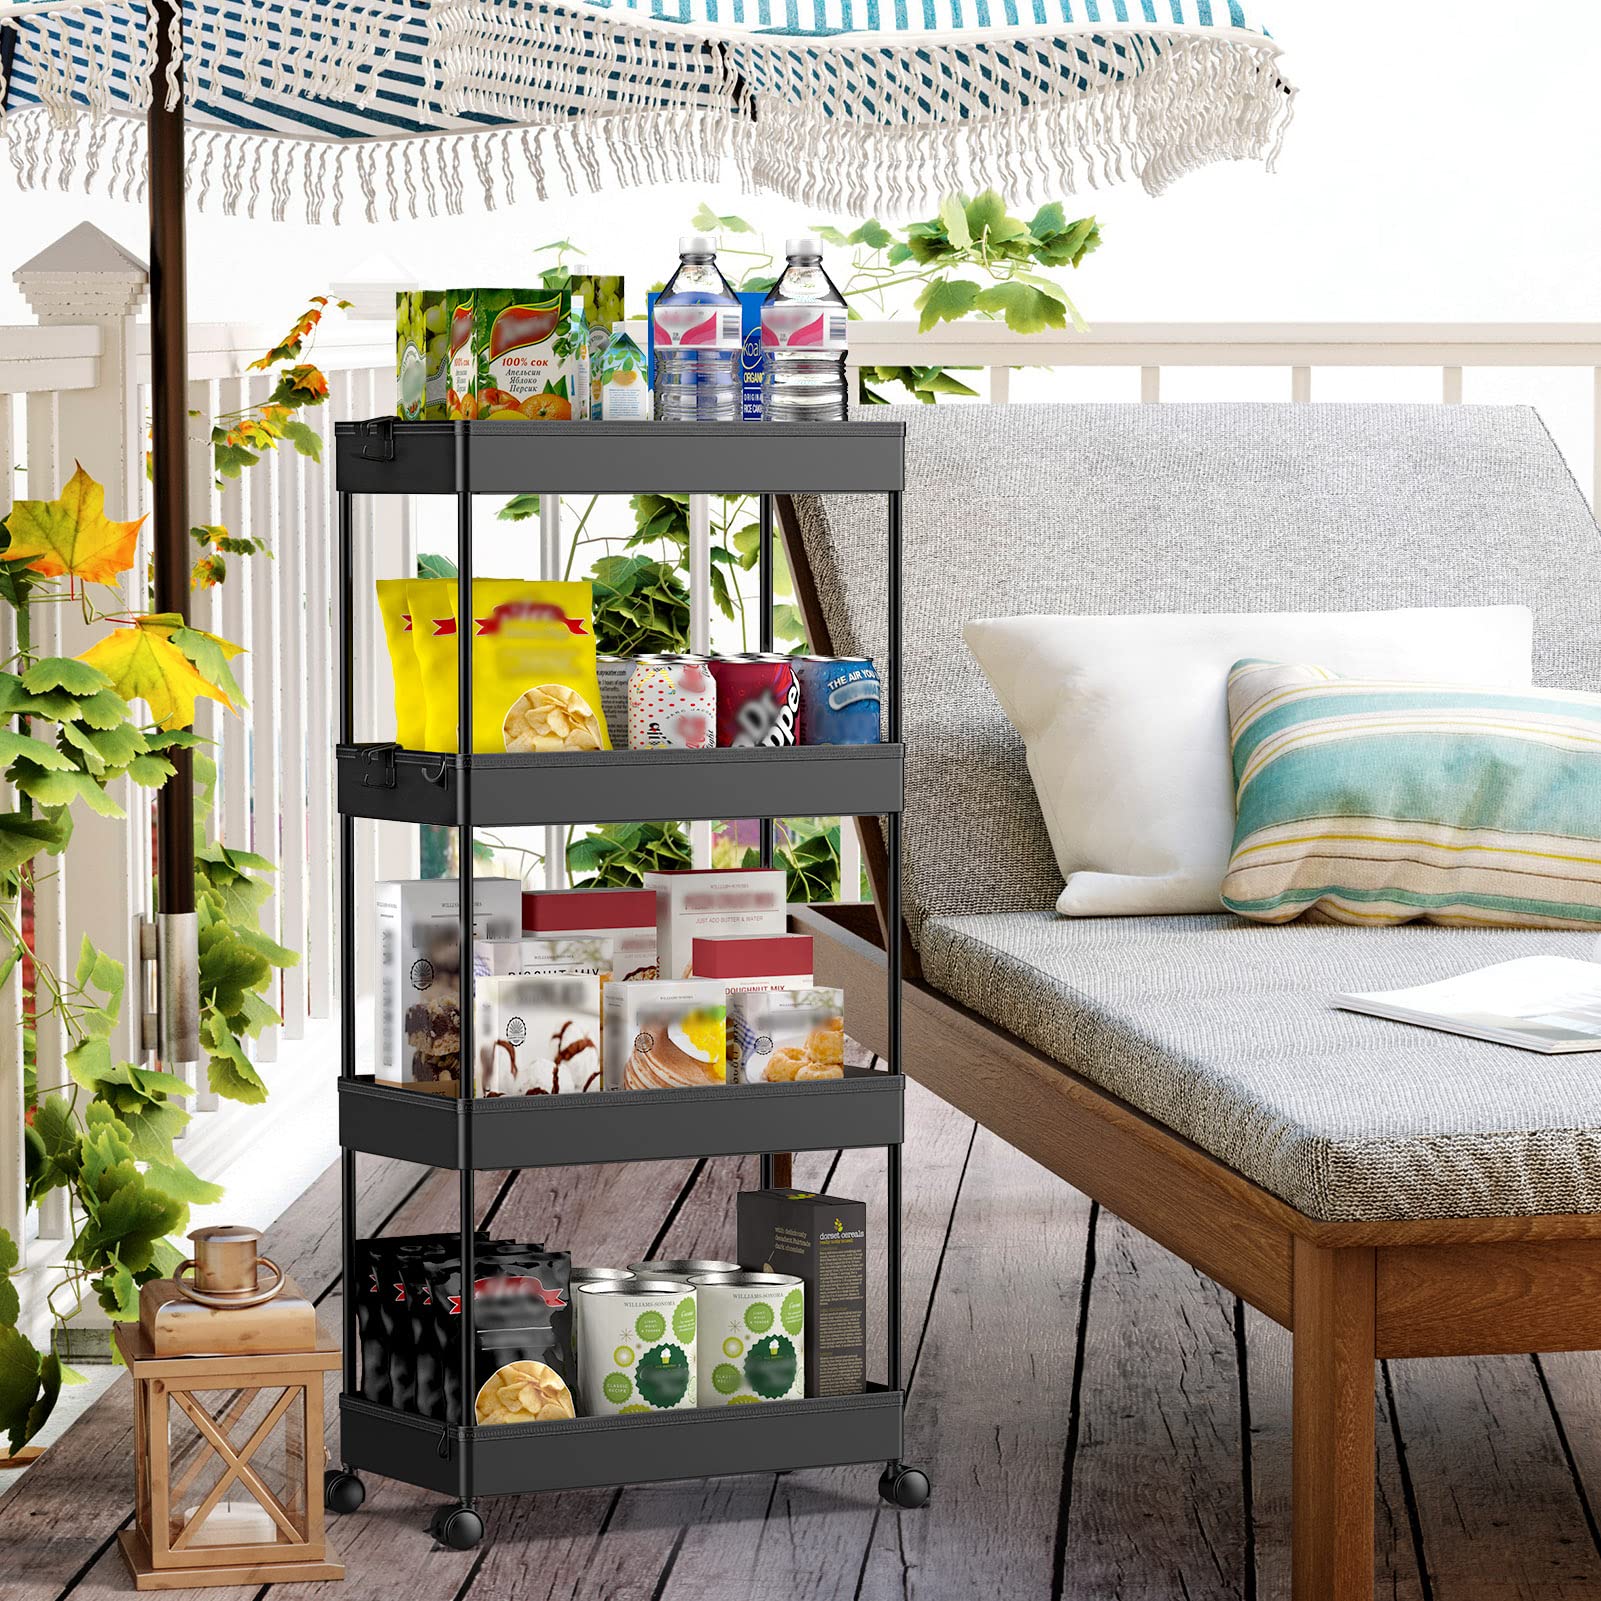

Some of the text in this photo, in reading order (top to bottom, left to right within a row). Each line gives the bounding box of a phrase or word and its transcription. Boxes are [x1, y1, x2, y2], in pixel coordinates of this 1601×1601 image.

[502, 357, 549, 367] 100% сок
[505, 368, 541, 376] Апельсин
[510, 376, 538, 384] Яблоко
[509, 384, 538, 394] Персик
[827, 676, 848, 690] THE
[848, 671, 863, 683] AIR
[819, 1229, 865, 1240] dorset cereals
[623, 1300, 676, 1308] WILLIAMS-SONOMA
